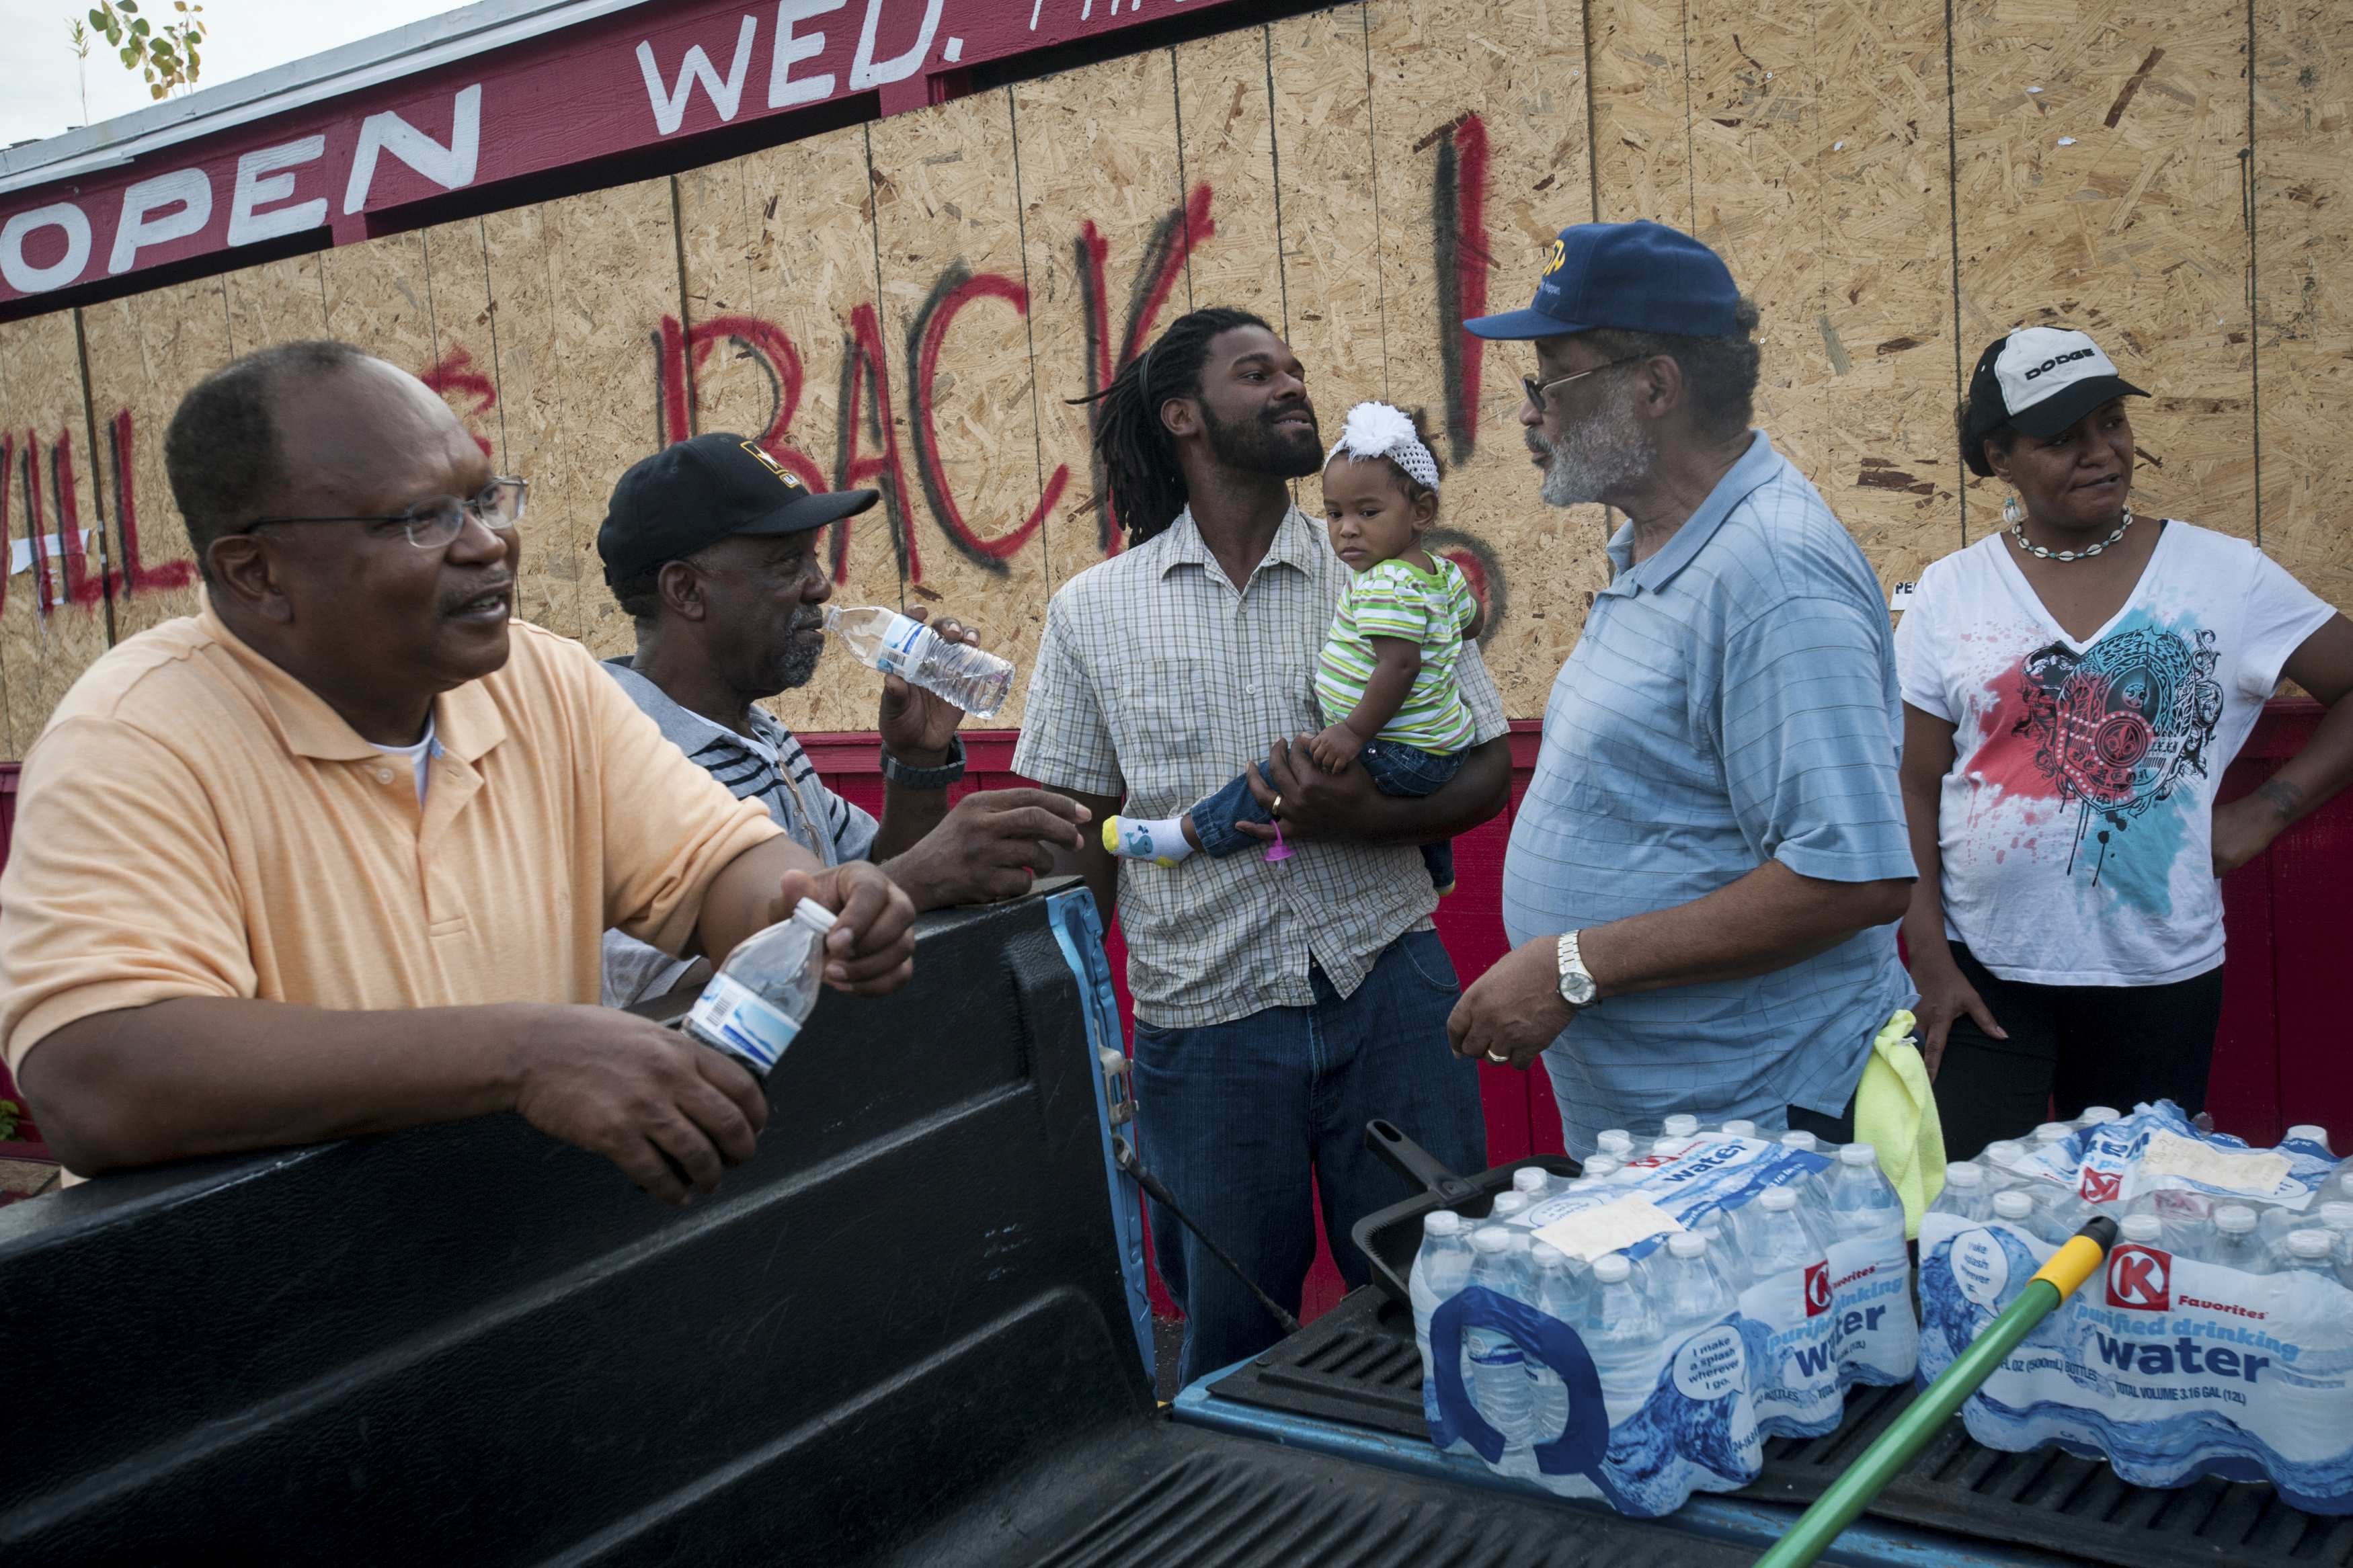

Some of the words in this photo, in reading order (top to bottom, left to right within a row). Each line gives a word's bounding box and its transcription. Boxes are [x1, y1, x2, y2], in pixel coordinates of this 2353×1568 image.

[0, 83, 481, 294] OPEN
[635, 0, 963, 135] WED.
[2024, 347, 2096, 381] DODGE
[0, 408, 198, 613] ILL
[1895, 581, 1917, 594] PE
[1663, 1145, 1749, 1182] water
[2118, 1255, 2163, 1305] K
[2178, 1294, 2266, 1320] Favorites
[1693, 1348, 1698, 1358] I
[1700, 1337, 1730, 1354] make
[2075, 1305, 2165, 1336] purified
[2171, 1317, 2301, 1362] drinking
[1688, 1359, 1739, 1383] wherever
[1689, 1362, 1698, 1371] a
[1700, 1348, 1736, 1367] splash
[2096, 1330, 2270, 1385] water
[1706, 1382, 1710, 1391] I
[2116, 1380, 2140, 1398] TOTAL
[2141, 1386, 2178, 1400] VOLUME
[2180, 1386, 2200, 1400] 3.16
[2202, 1385, 2223, 1398] GAL
